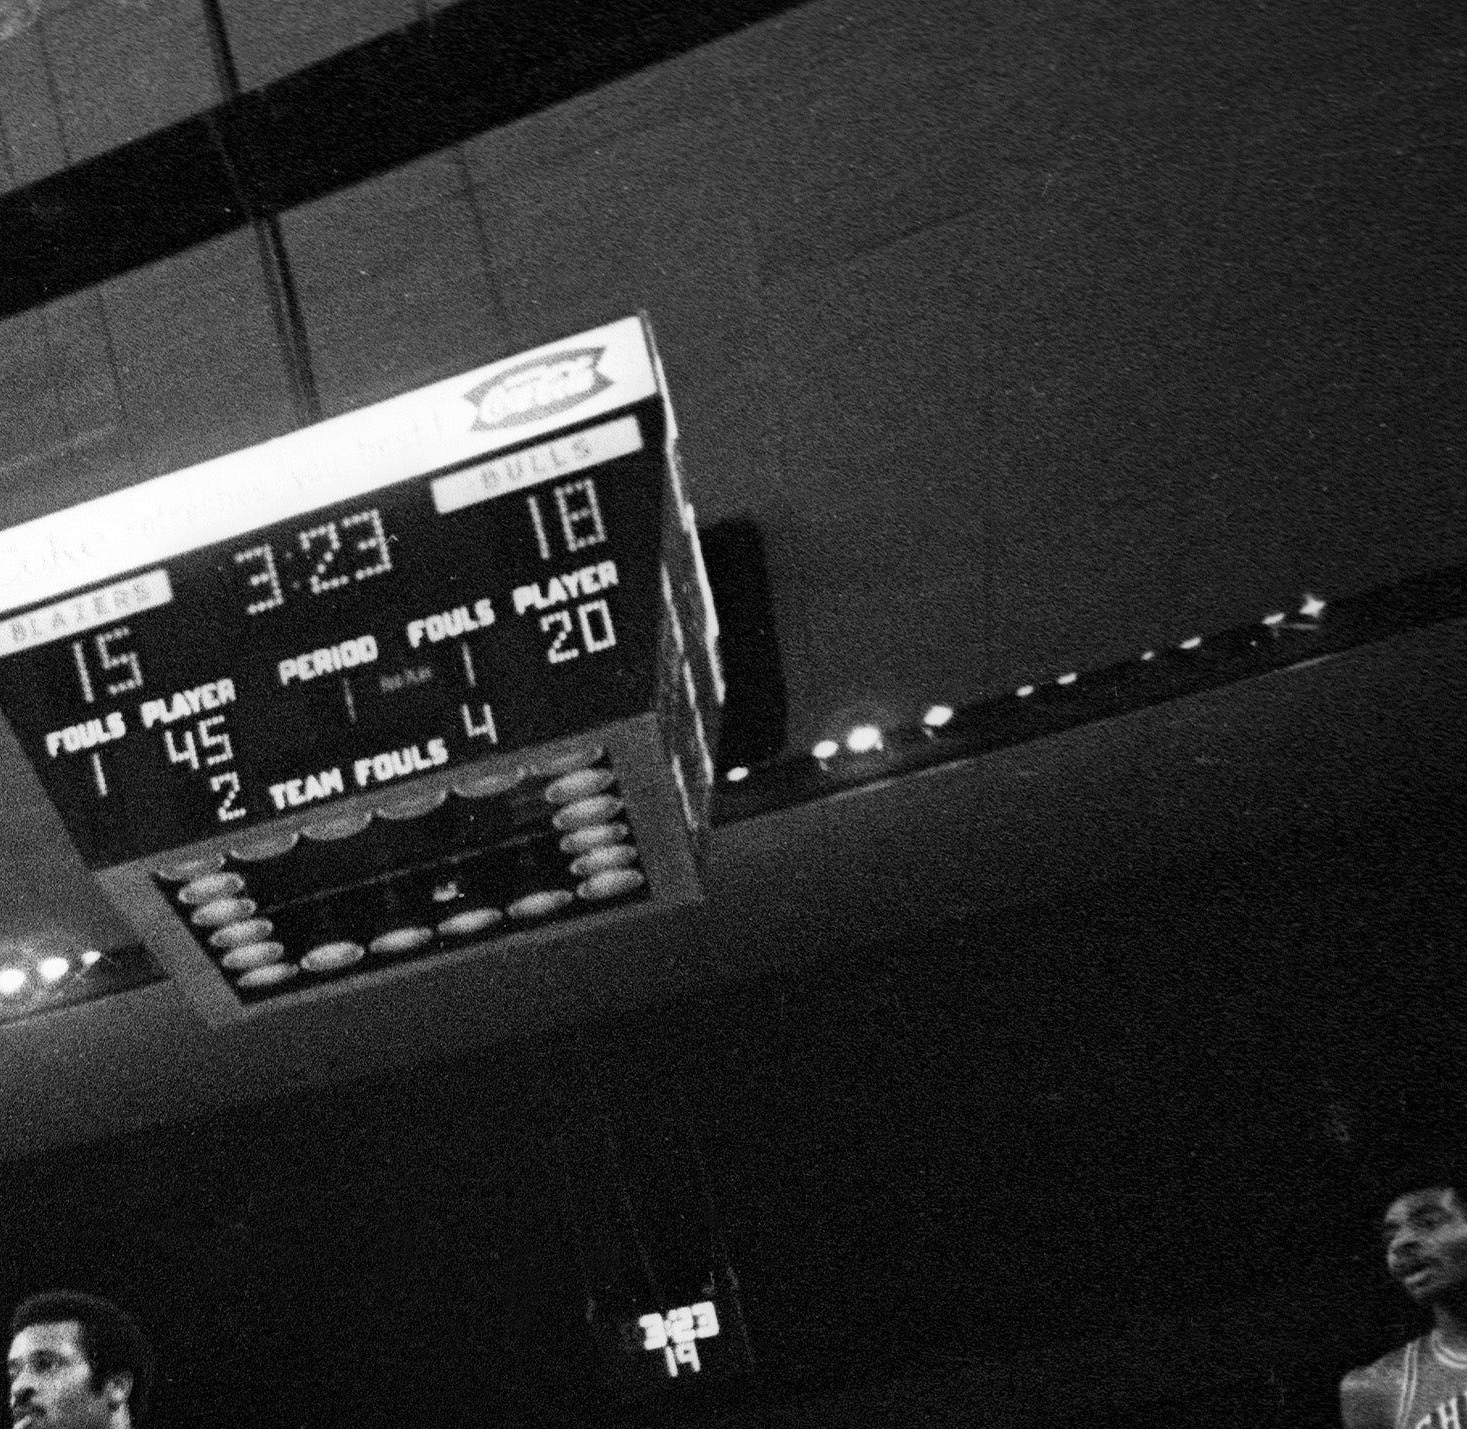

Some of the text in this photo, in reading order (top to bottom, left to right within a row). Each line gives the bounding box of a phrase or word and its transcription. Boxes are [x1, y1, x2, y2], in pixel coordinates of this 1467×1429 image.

[480, 438, 592, 490] BULLS
[527, 478, 608, 560] 18
[512, 560, 619, 616] PLAYER
[406, 598, 495, 649] FOULS
[540, 599, 616, 664] 20
[73, 626, 144, 703] 15
[278, 634, 378, 686] PERIOD
[461, 642, 476, 688] 1
[45, 678, 236, 758] FOULS PLAYER
[165, 714, 234, 771] 45
[462, 703, 498, 744] 4
[93, 752, 109, 797] 1
[210, 771, 247, 822] 2
[269, 737, 448, 810] TEAM FOULS
